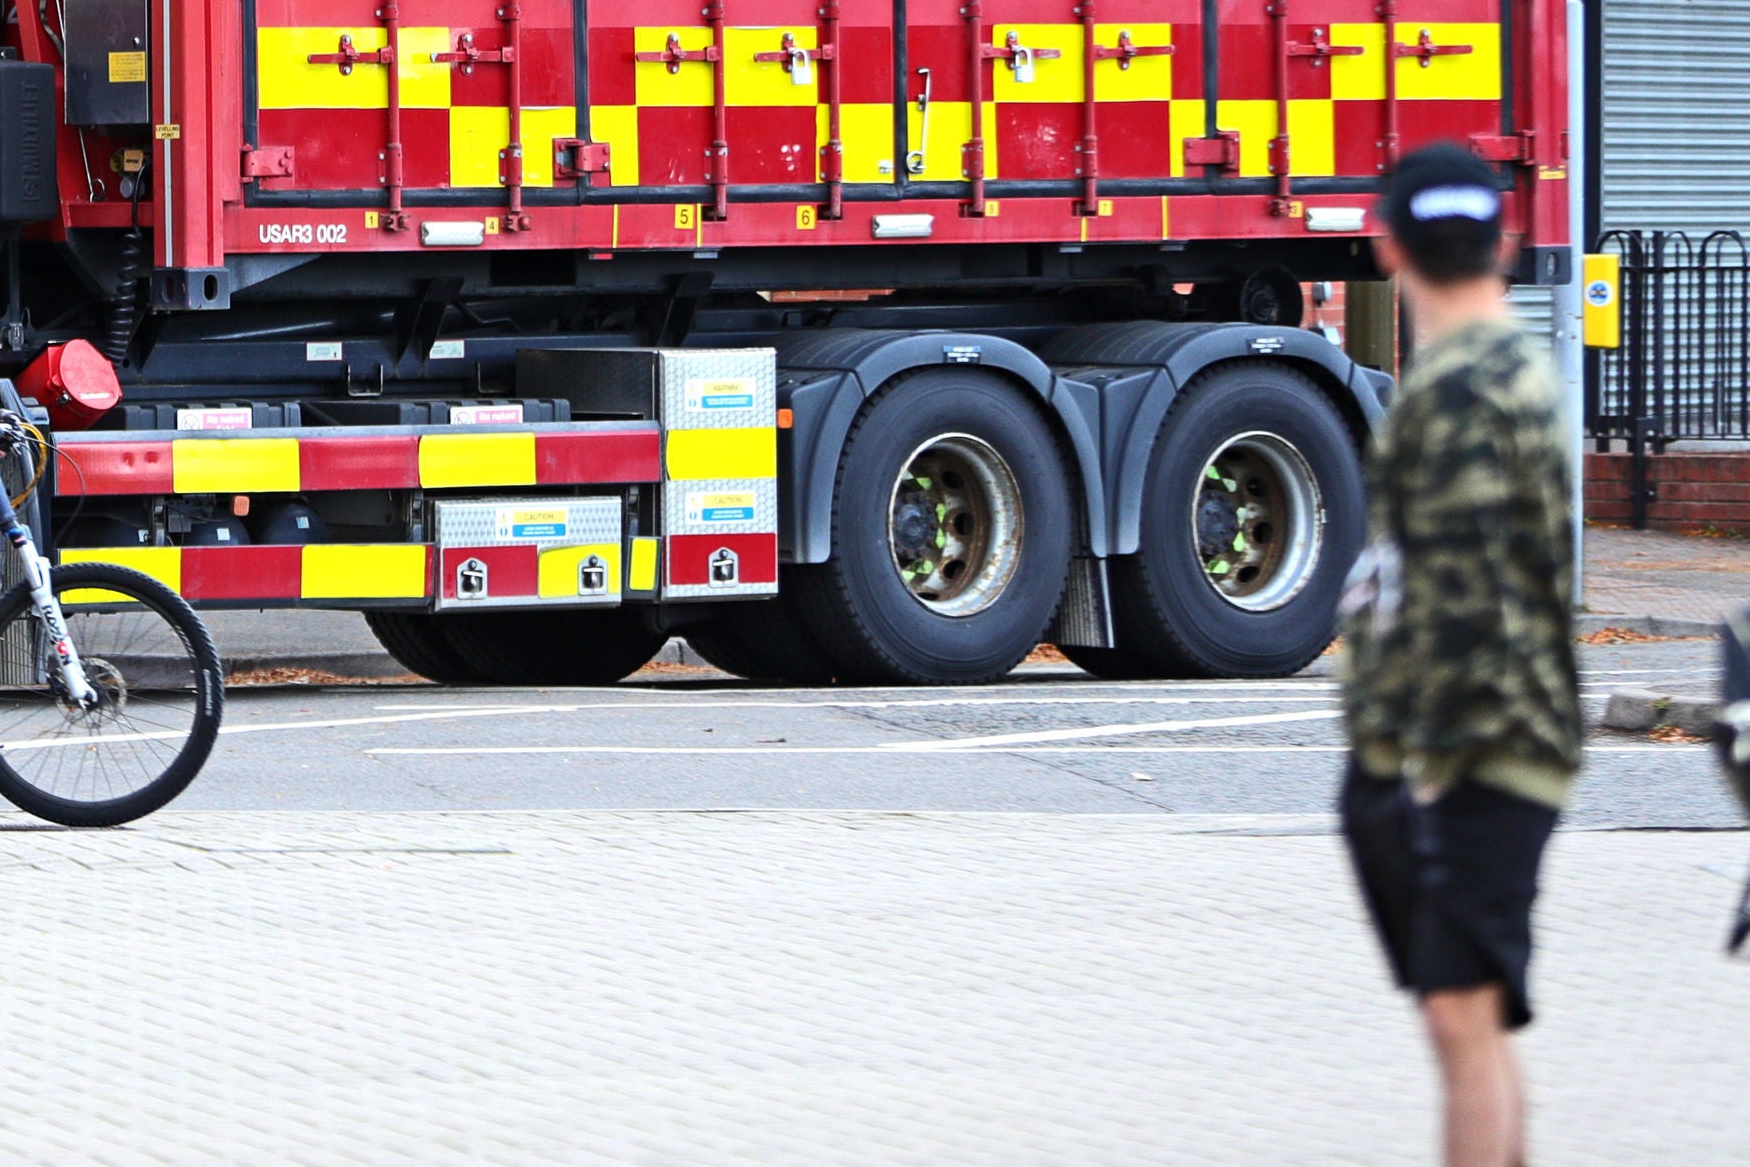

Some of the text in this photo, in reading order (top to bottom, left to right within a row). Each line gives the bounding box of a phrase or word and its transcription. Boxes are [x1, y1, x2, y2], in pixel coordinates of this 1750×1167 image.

[680, 209, 689, 225] 5
[801, 210, 810, 225] 6
[488, 221, 495, 230] 4
[259, 224, 347, 244] USAR3 002
[524, 513, 554, 521] CAUTION
